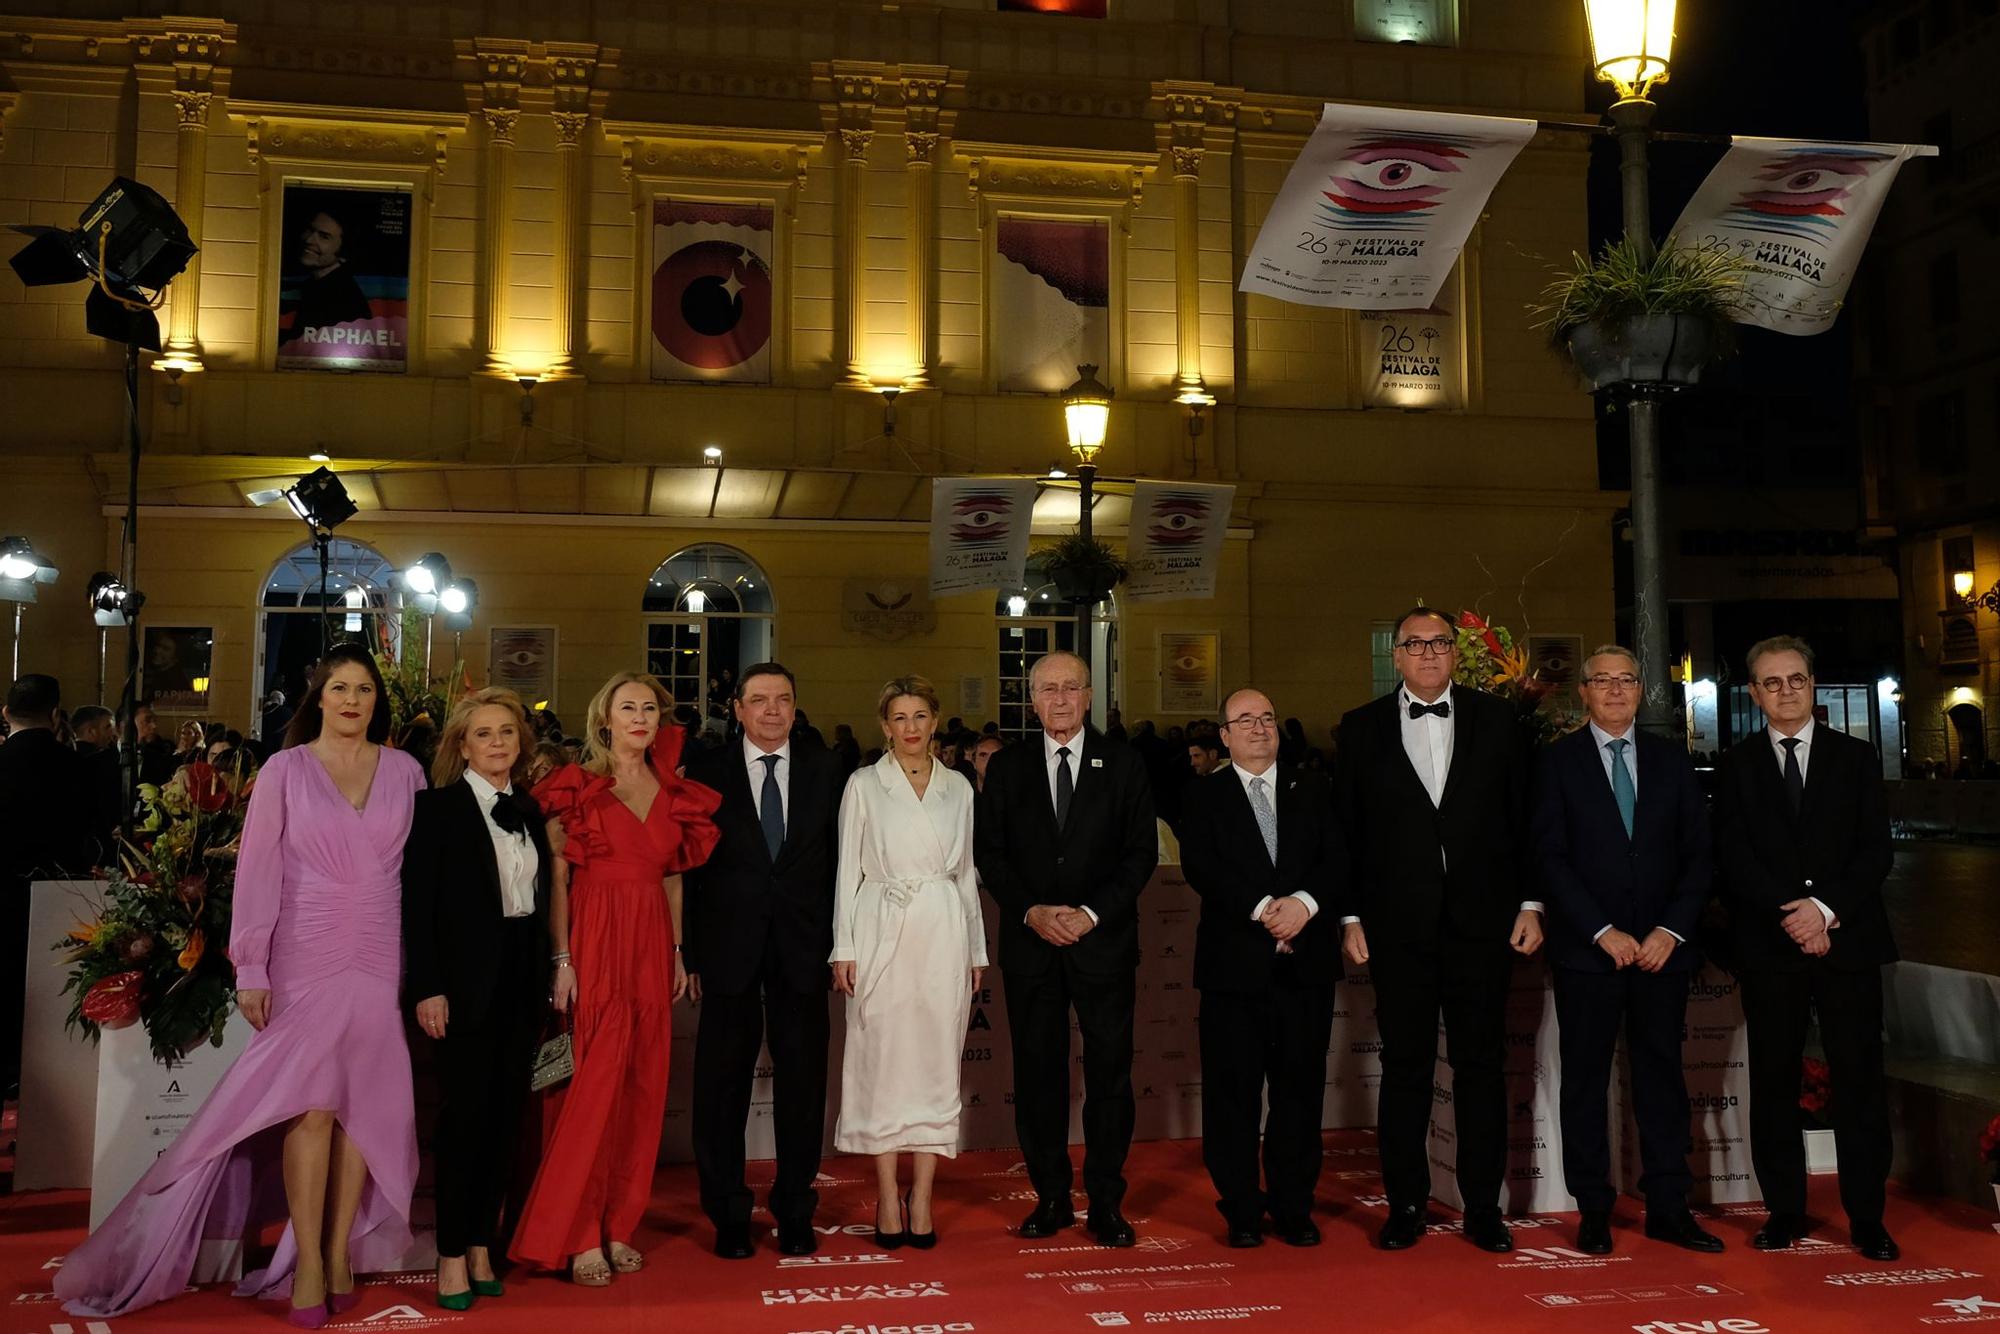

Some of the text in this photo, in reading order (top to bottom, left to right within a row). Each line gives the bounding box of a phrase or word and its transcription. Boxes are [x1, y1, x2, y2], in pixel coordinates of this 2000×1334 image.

[1296, 231, 1327, 254] 26
[1355, 238, 1425, 248] FESTIVAL DE
[1758, 241, 1827, 270] FESTIVAL DE
[303, 326, 401, 347] RAPHAEL
[1381, 325, 1415, 352] 26
[1381, 354, 1441, 364] FESTIVAL DE
[1399, 382, 1424, 390] MARZO
[946, 555, 961, 567] 26
[779, 1253, 897, 1266] SUR
[1824, 1272, 1985, 1286] VICTORIA
[762, 1281, 945, 1297] FESTIVAL DE
[1143, 1305, 1282, 1319] Ayuntamiento
[1632, 1318, 1773, 1334] rtve
